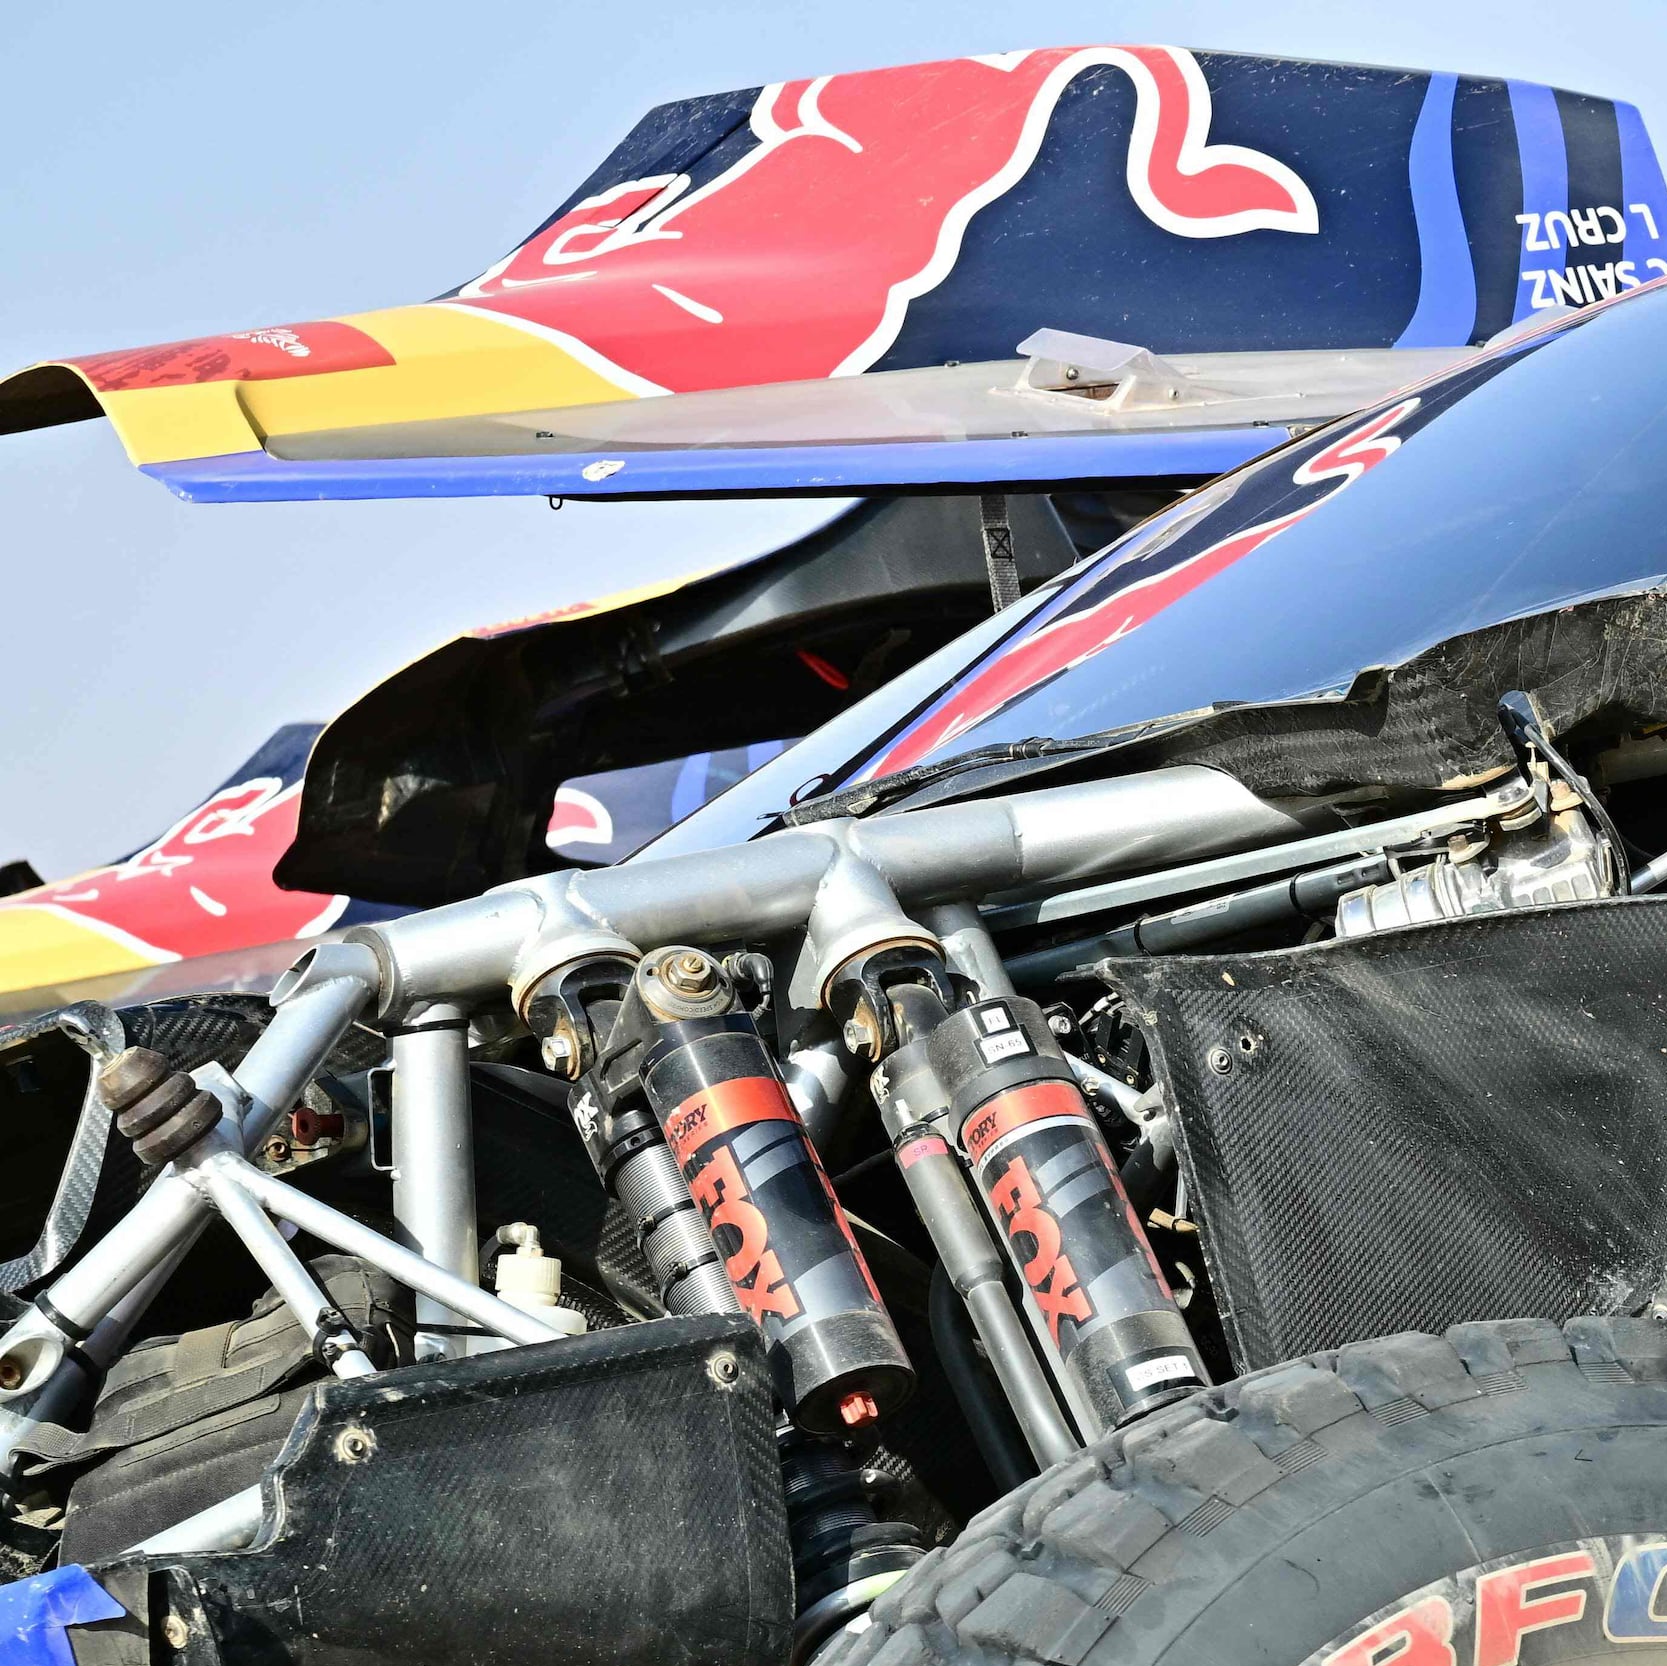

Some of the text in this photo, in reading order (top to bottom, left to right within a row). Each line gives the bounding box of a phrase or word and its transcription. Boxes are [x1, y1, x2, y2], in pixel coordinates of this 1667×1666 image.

[1515, 203, 1660, 251] L CRUZ
[1522, 261, 1641, 309] SAINZ
[688, 1144, 800, 1327] FOX
[989, 1154, 1093, 1351] FOX
